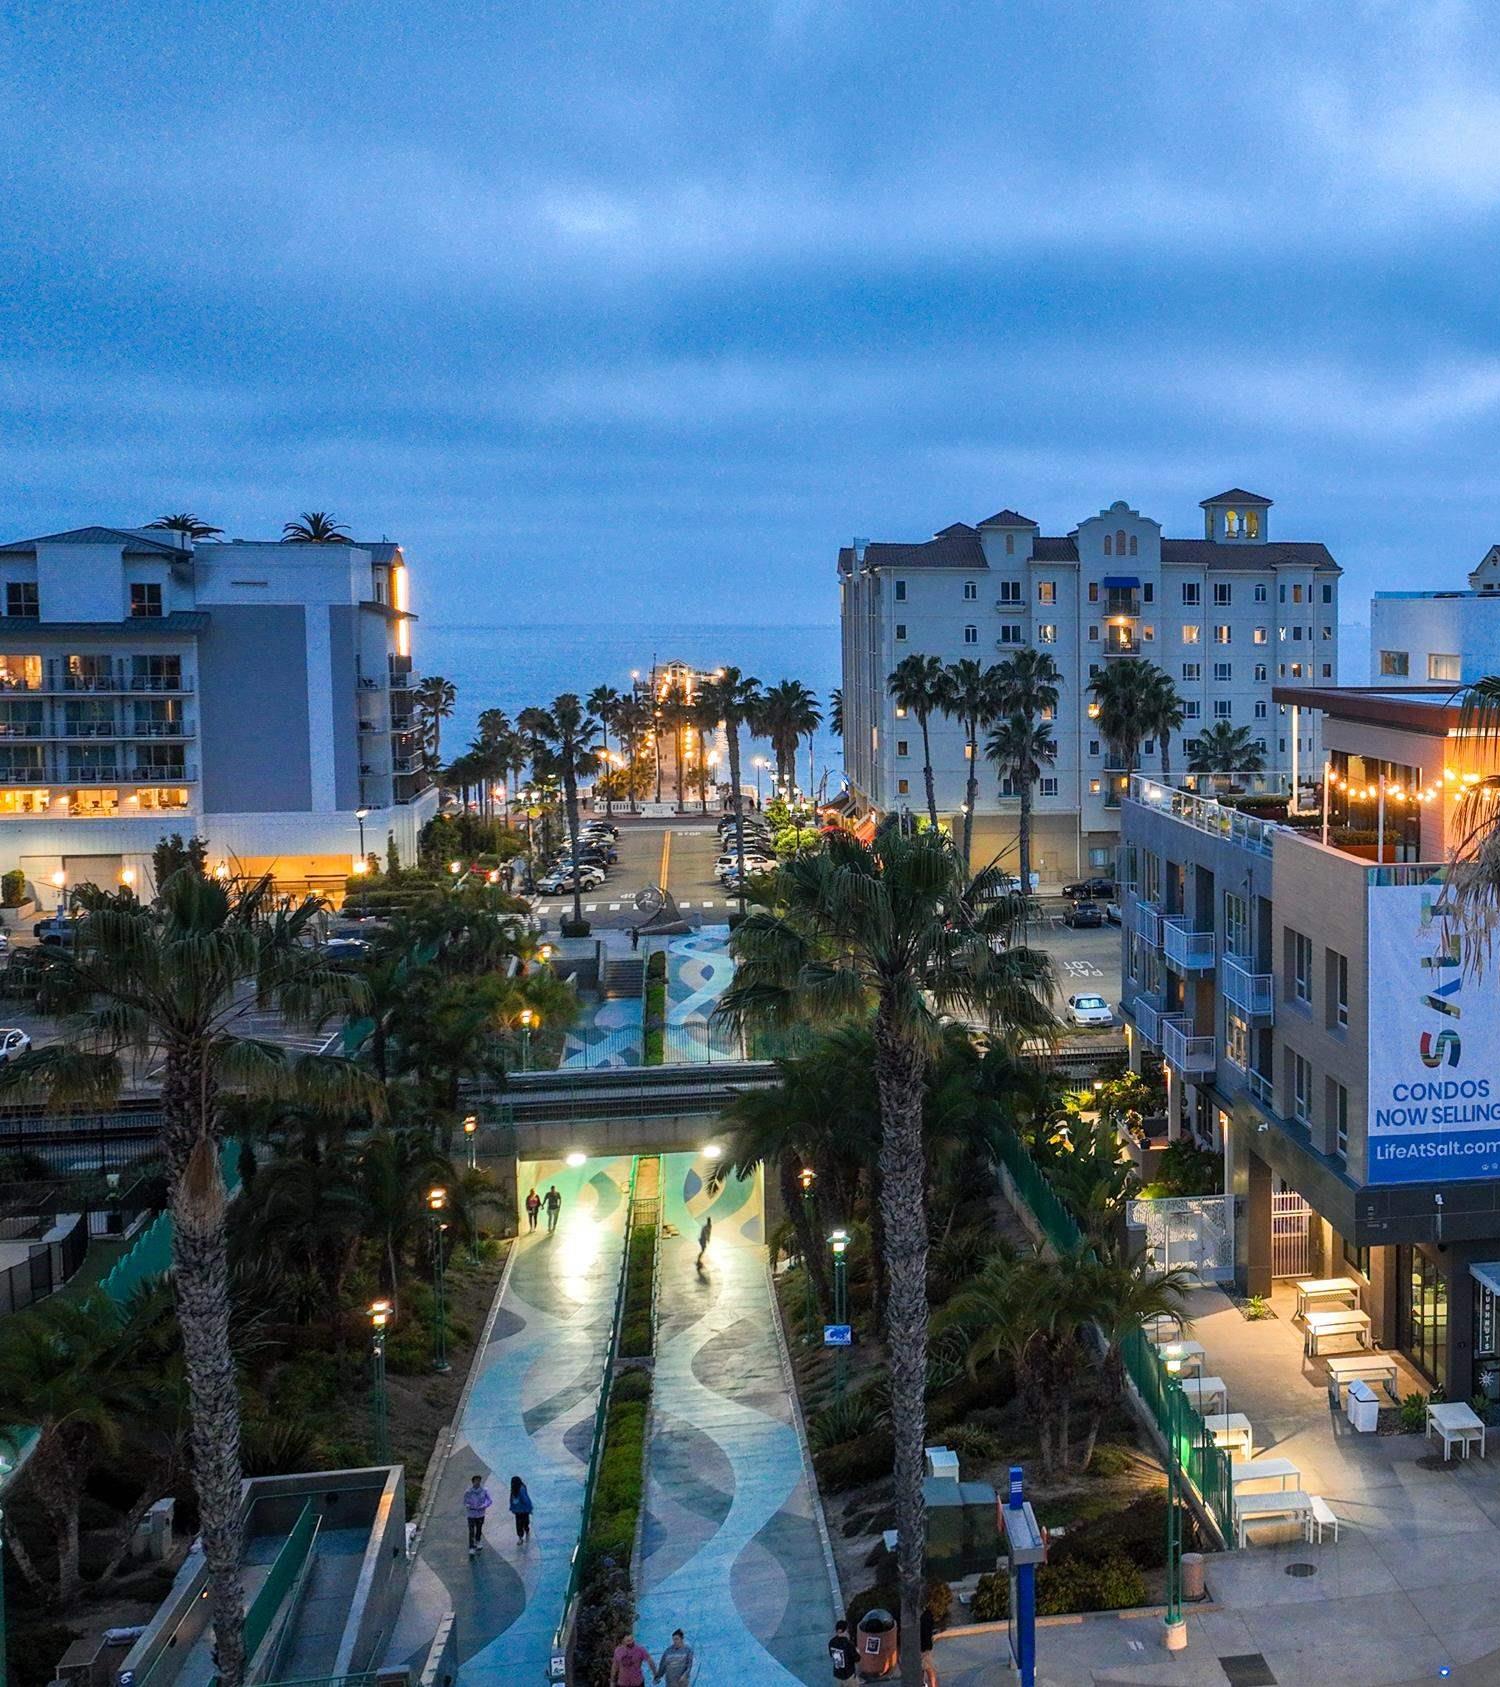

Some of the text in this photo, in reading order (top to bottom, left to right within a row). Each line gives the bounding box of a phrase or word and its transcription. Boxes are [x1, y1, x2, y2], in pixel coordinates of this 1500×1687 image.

[1063, 960, 1095, 970] LOT
[1069, 968, 1104, 978] PAY
[1392, 1079, 1491, 1102] CONDOS
[1376, 1107, 1428, 1128] NOW
